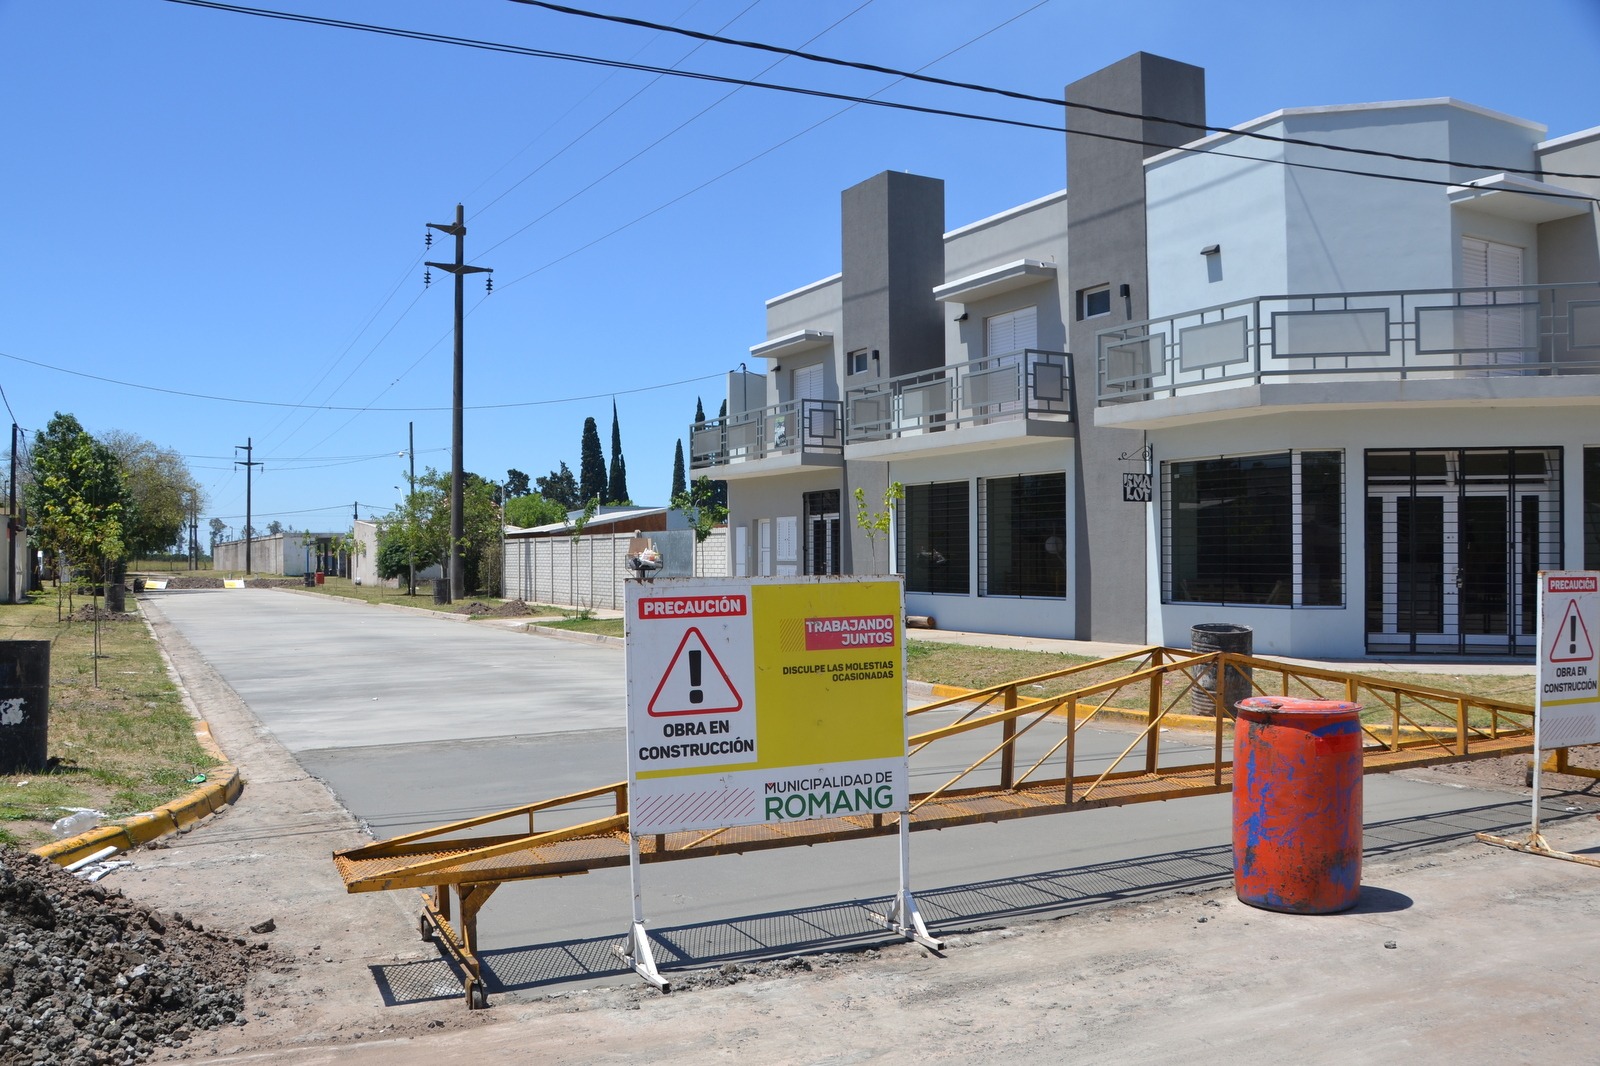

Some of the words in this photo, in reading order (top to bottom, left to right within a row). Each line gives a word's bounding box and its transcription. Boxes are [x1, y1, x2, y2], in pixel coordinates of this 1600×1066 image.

[1550, 577, 1595, 590] PRECAUCIÓN
[643, 596, 741, 616] PRECAUCIÓN
[806, 617, 893, 632] TRABAJANDO
[841, 631, 893, 646] JUNTOS
[782, 664, 826, 675] DISCULPE
[826, 663, 844, 673] LAS
[845, 660, 894, 671] MOLESTIAS
[1556, 666, 1576, 678] OBRA
[1577, 666, 1587, 676] EN
[832, 670, 894, 682] OCASIONADAS
[1544, 679, 1597, 694] CONSTRUCCIÓN
[663, 722, 707, 738] OBRA
[710, 719, 730, 734] EN
[638, 737, 754, 761] CONSTRUCCIÓN
[764, 773, 873, 794] MUNICIPALIDAD
[875, 771, 893, 784] DE
[765, 785, 893, 821] ROMANG
